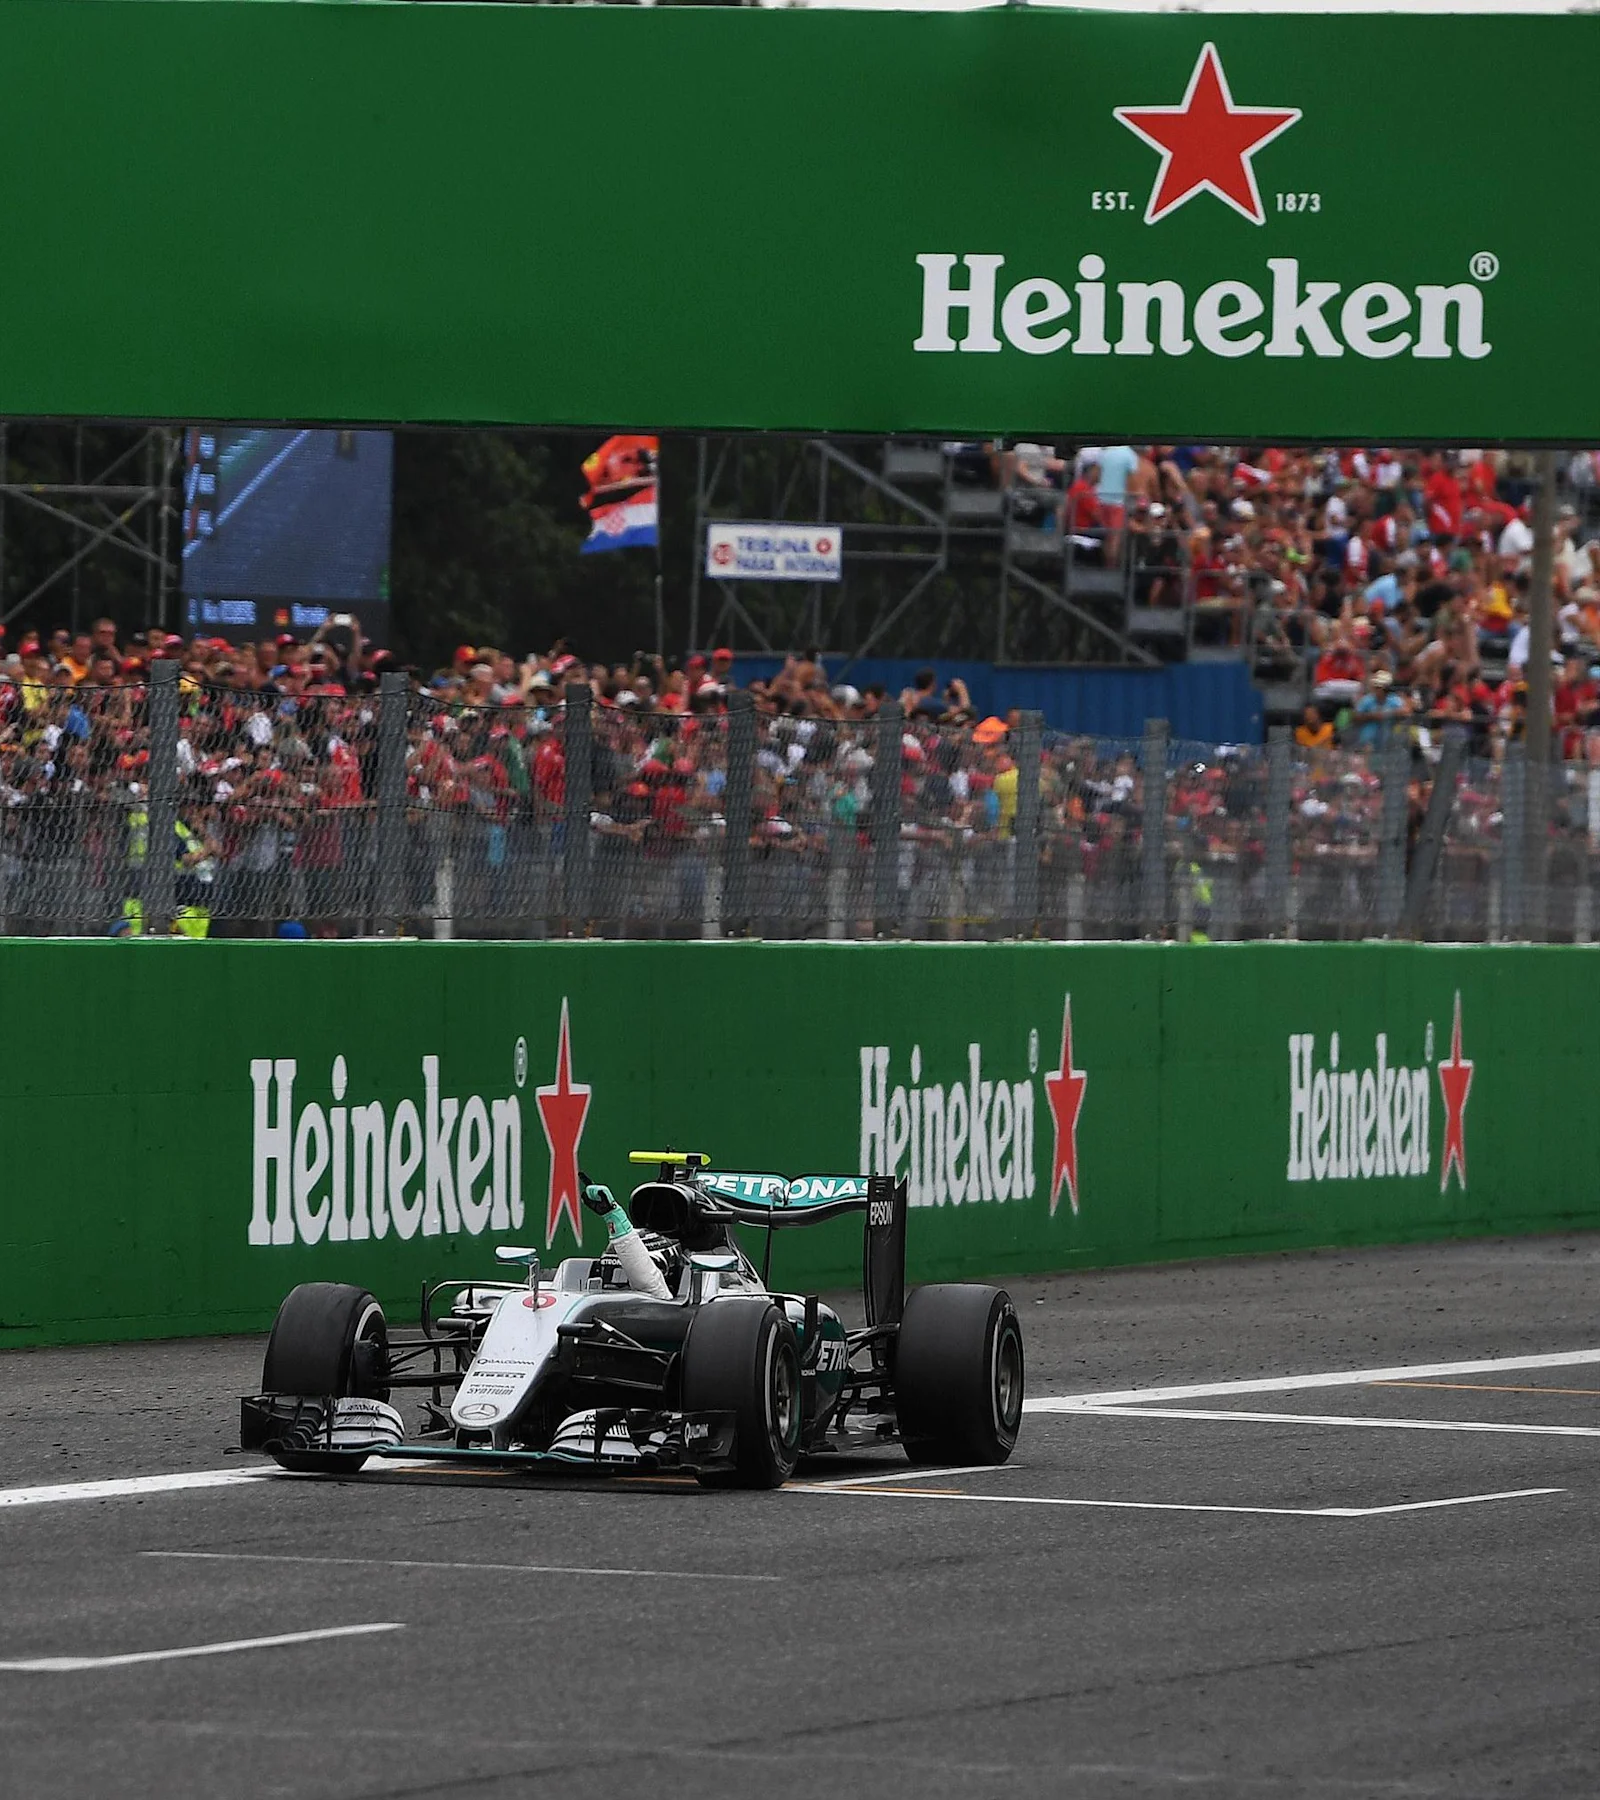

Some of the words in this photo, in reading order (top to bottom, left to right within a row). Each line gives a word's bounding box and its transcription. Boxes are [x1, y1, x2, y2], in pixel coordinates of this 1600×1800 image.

[1091, 191, 1136, 212] EST.
[1275, 193, 1322, 213] 1873
[913, 253, 1493, 359] Heineken
[737, 535, 811, 553] TRIBUNA
[858, 1042, 1036, 1208] Heineken
[1286, 1031, 1431, 1181] Heineken
[248, 1053, 525, 1246] Heineken
[869, 1201, 894, 1227] EPSON
